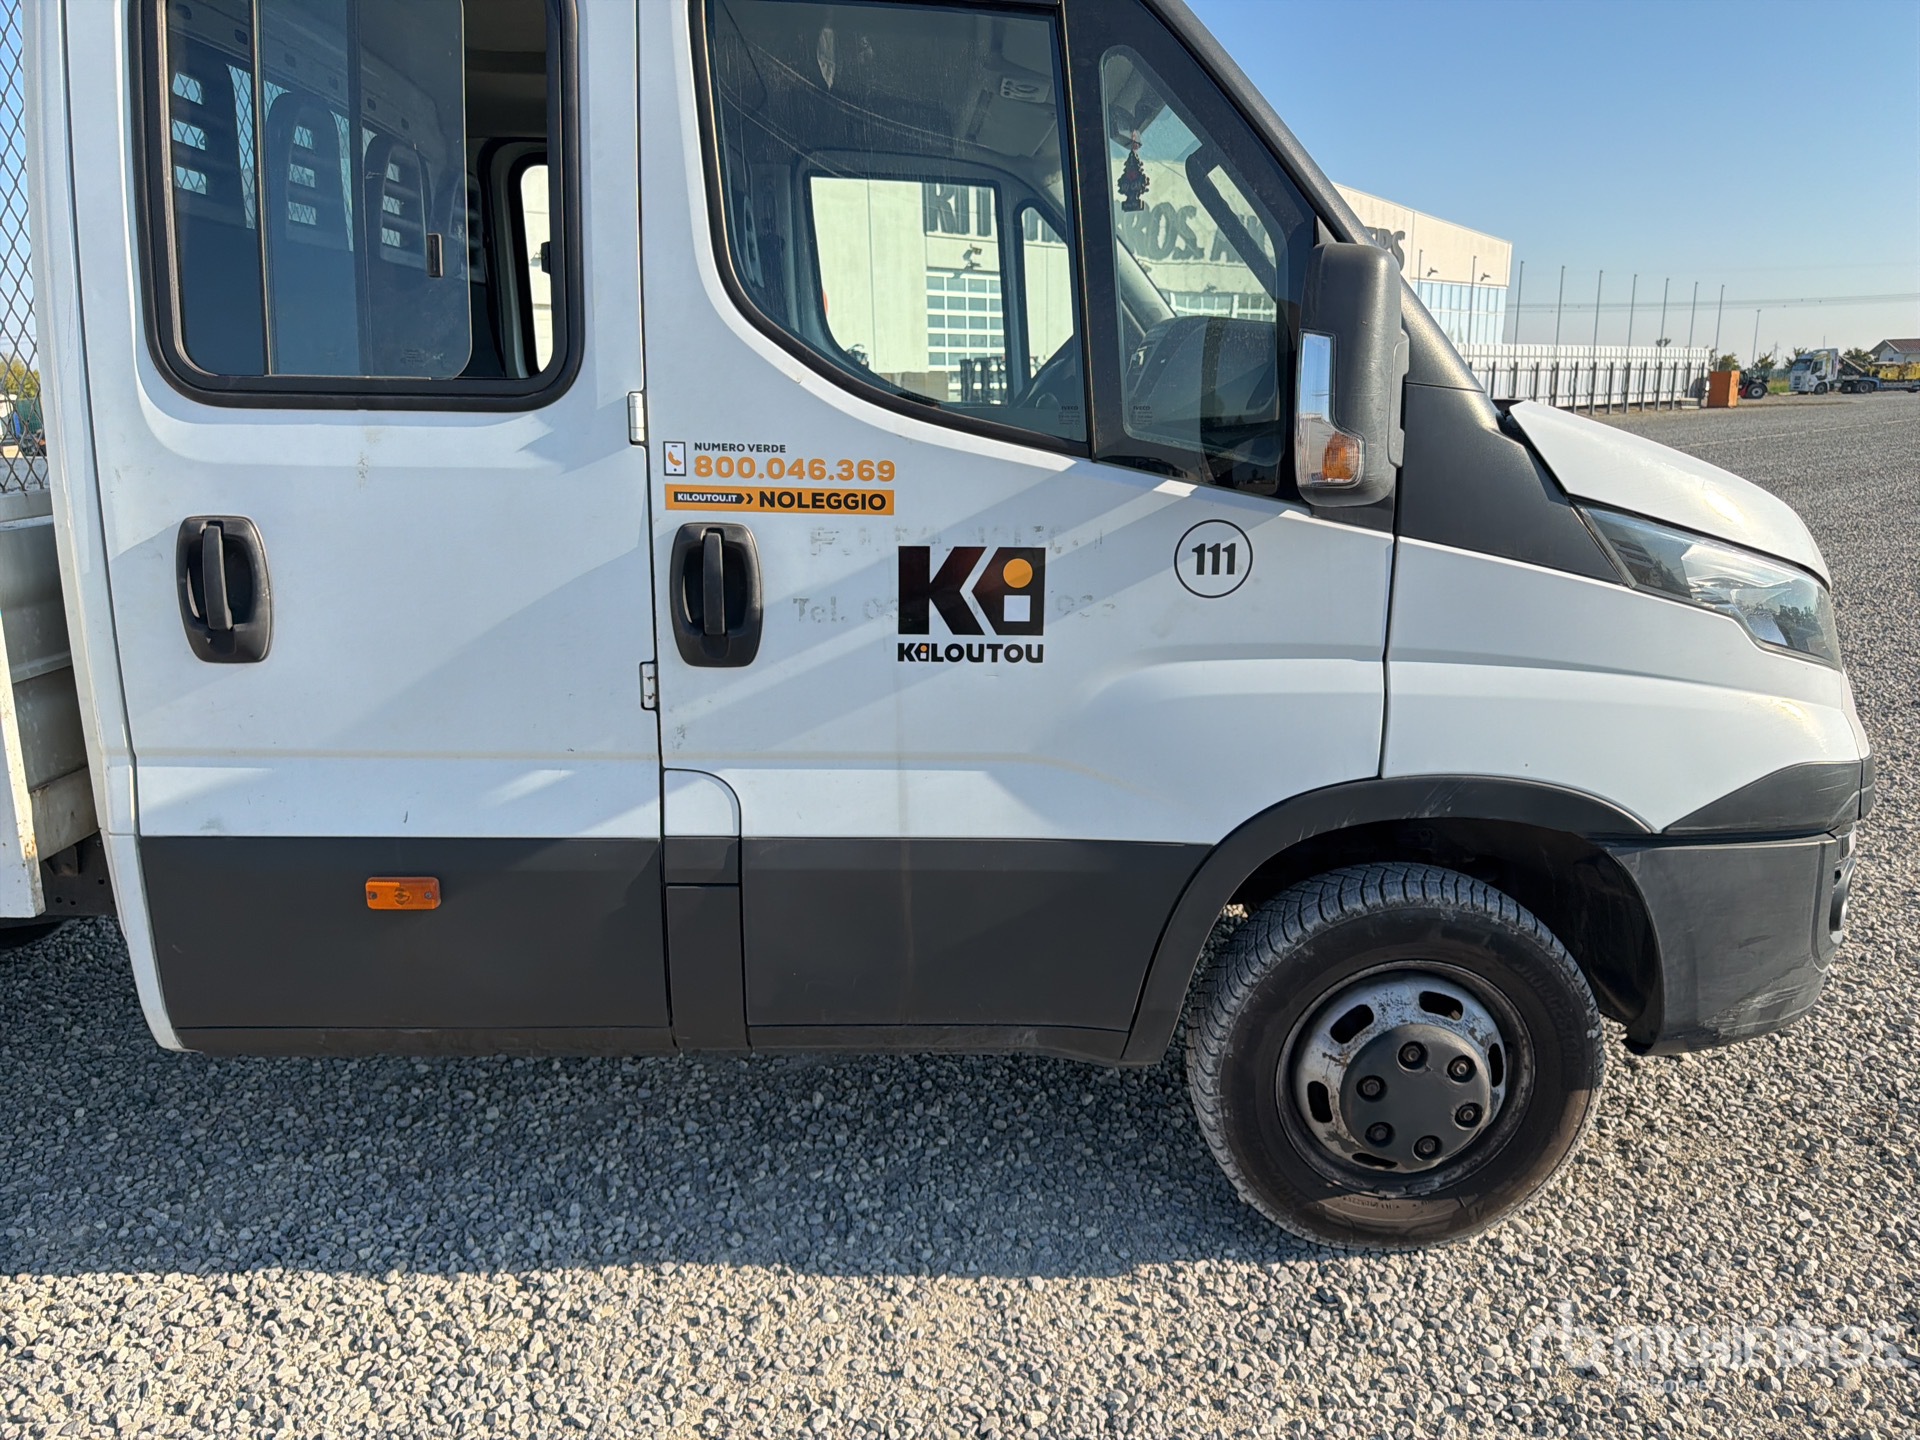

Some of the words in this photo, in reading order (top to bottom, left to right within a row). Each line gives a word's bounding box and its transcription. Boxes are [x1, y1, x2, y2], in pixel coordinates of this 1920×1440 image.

[694, 442, 745, 452] NUMERO
[747, 443, 786, 453] VERDE
[694, 455, 895, 482] 800.046.369
[677, 493, 737, 503] KILOUTOU.IT
[759, 491, 887, 510] NOLEGGIO
[1192, 543, 1236, 575] 111
